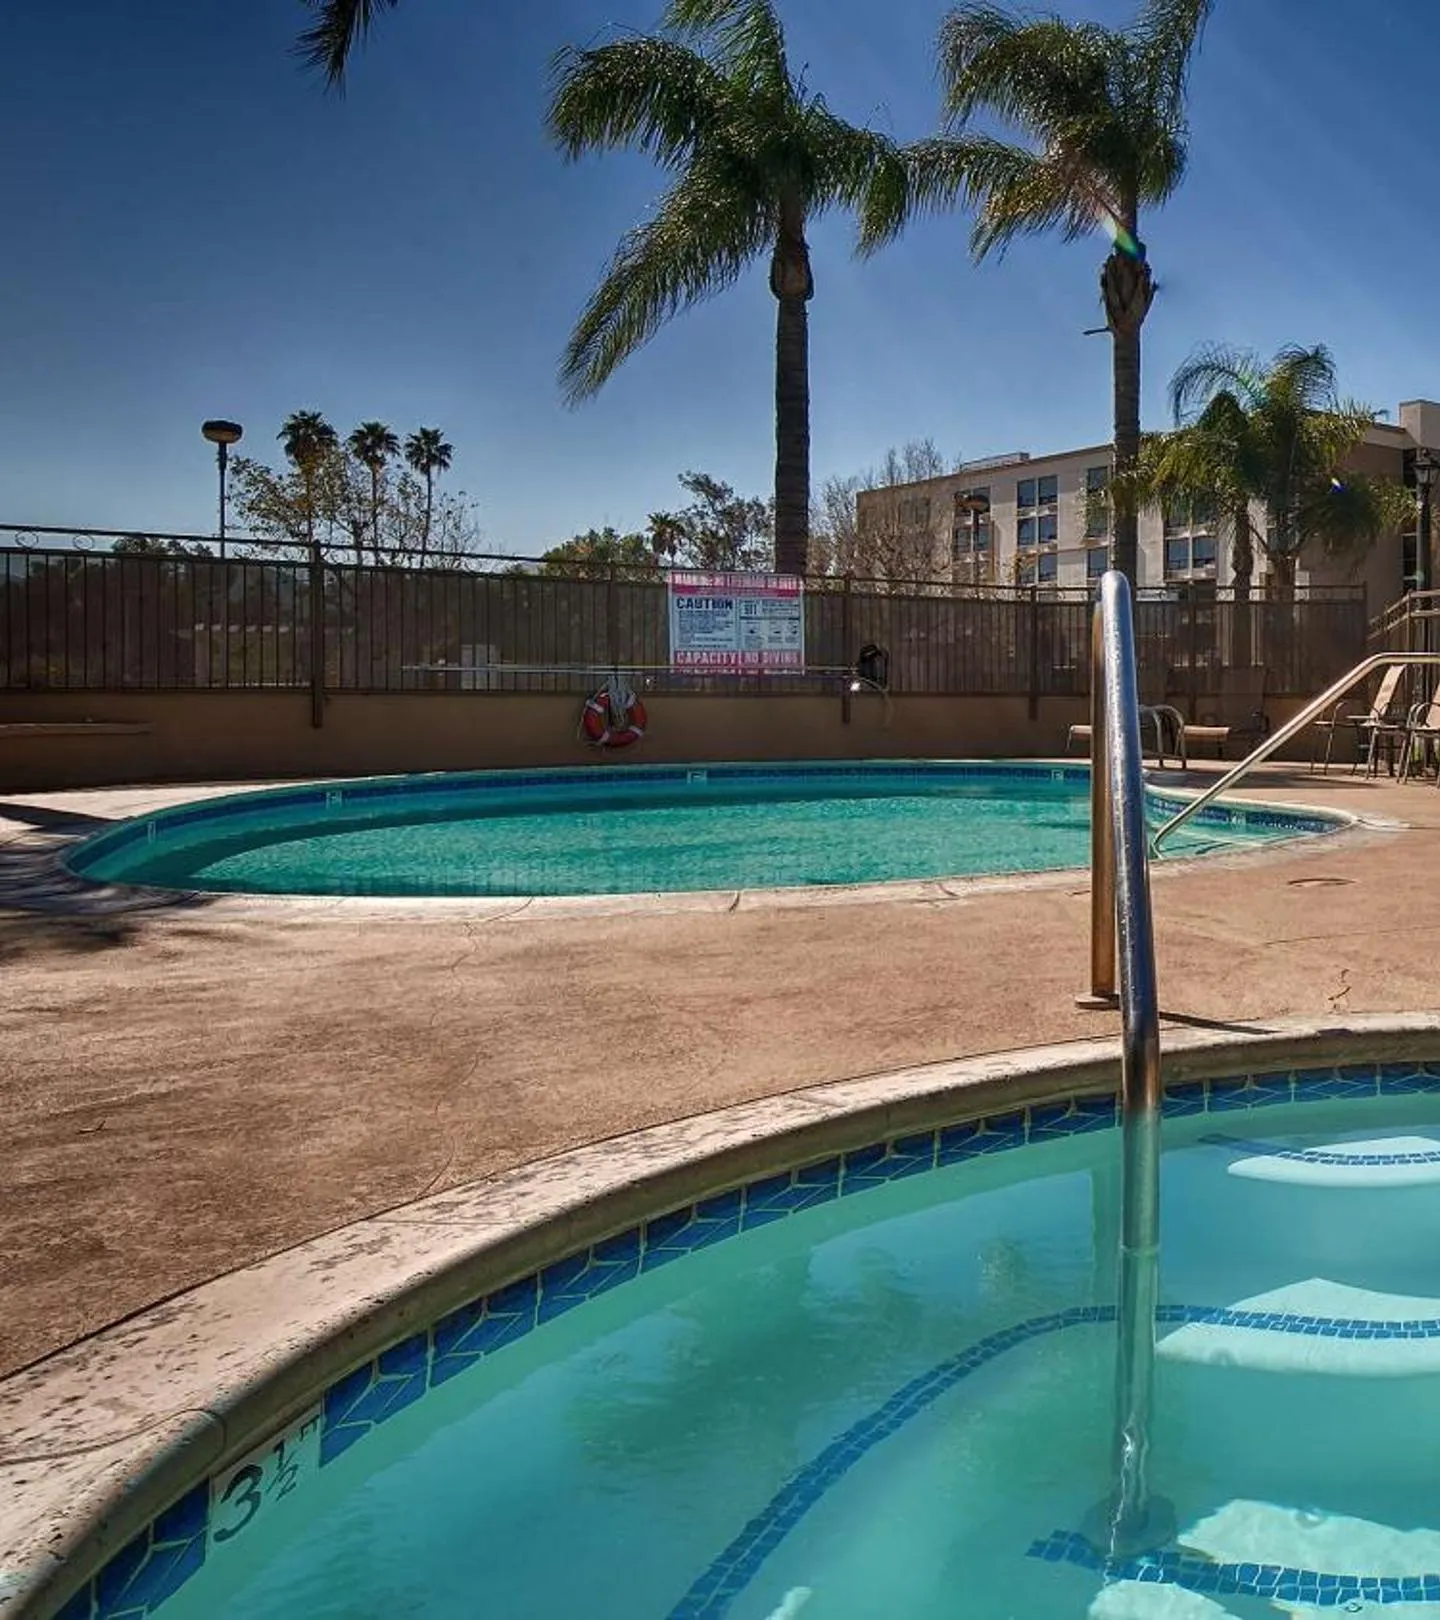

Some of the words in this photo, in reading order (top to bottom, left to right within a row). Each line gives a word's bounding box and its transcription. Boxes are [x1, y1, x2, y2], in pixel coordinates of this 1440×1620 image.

[676, 598, 733, 609] CAUTION
[676, 651, 737, 665] CAPACITY
[213, 1464, 264, 1543] 3
